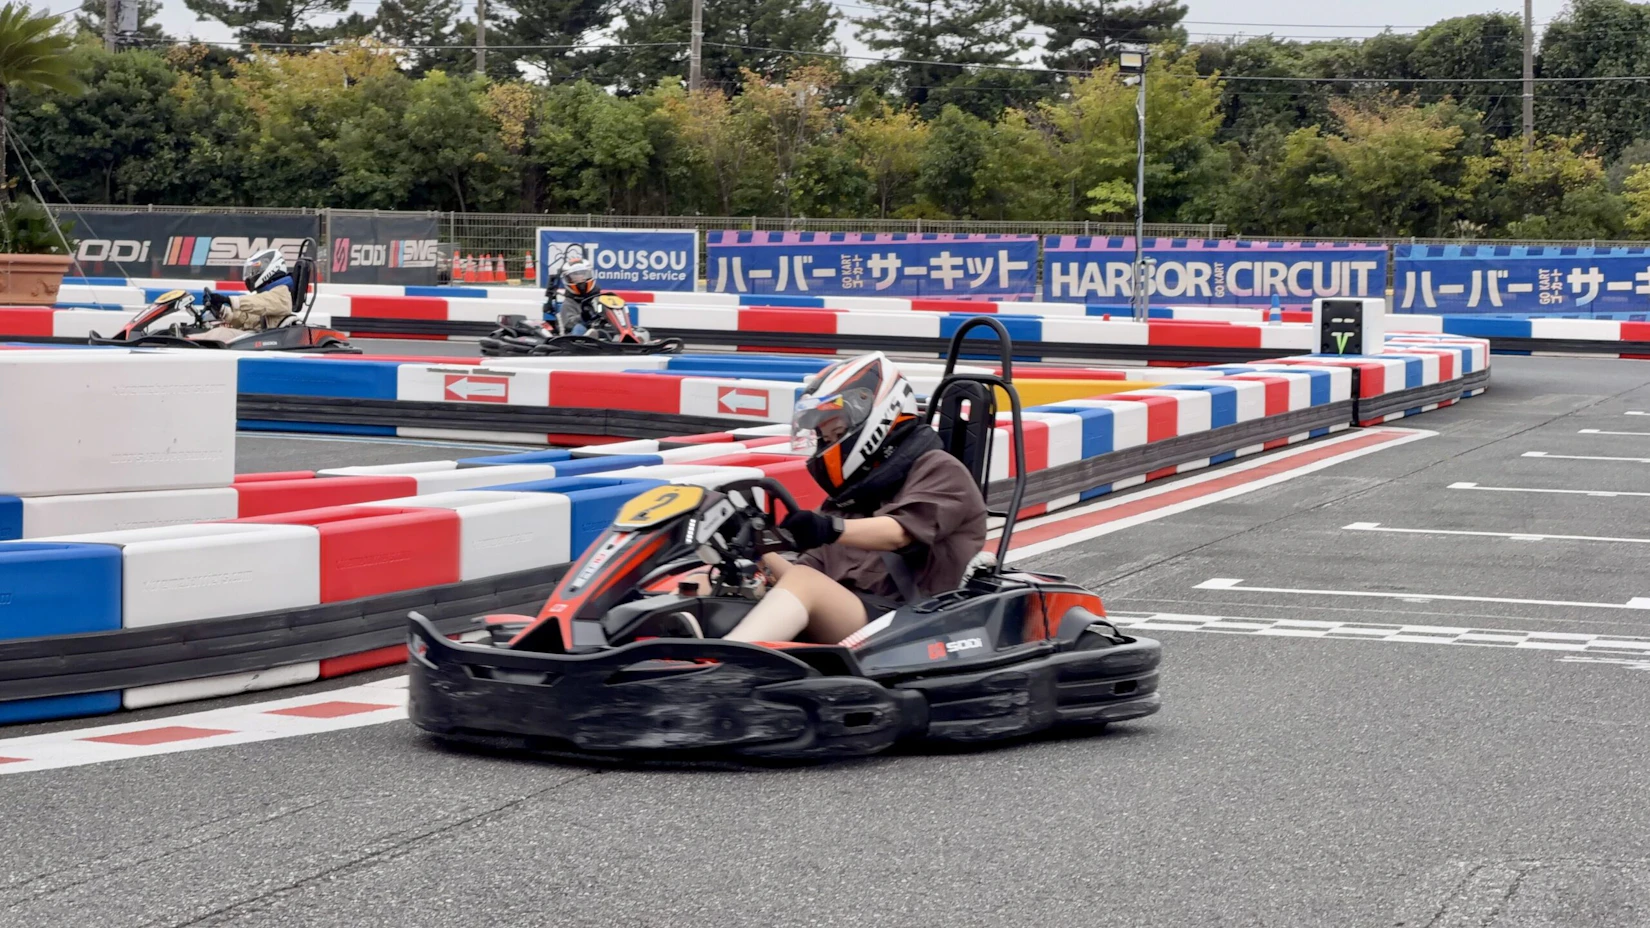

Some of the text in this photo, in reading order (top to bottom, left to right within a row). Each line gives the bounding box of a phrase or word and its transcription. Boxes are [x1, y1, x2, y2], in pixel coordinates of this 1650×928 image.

[594, 269, 686, 282] lanning Service
[714, 249, 1028, 292] ハーバー サーキット
[841, 254, 852, 289] GO KART
[1052, 261, 1377, 297] HARBOR CIRCUIT
[1214, 262, 1225, 298] GO KART
[1401, 269, 1533, 308] ハーバー
[1538, 268, 1551, 305] GO KART
[628, 493, 680, 522] 2
